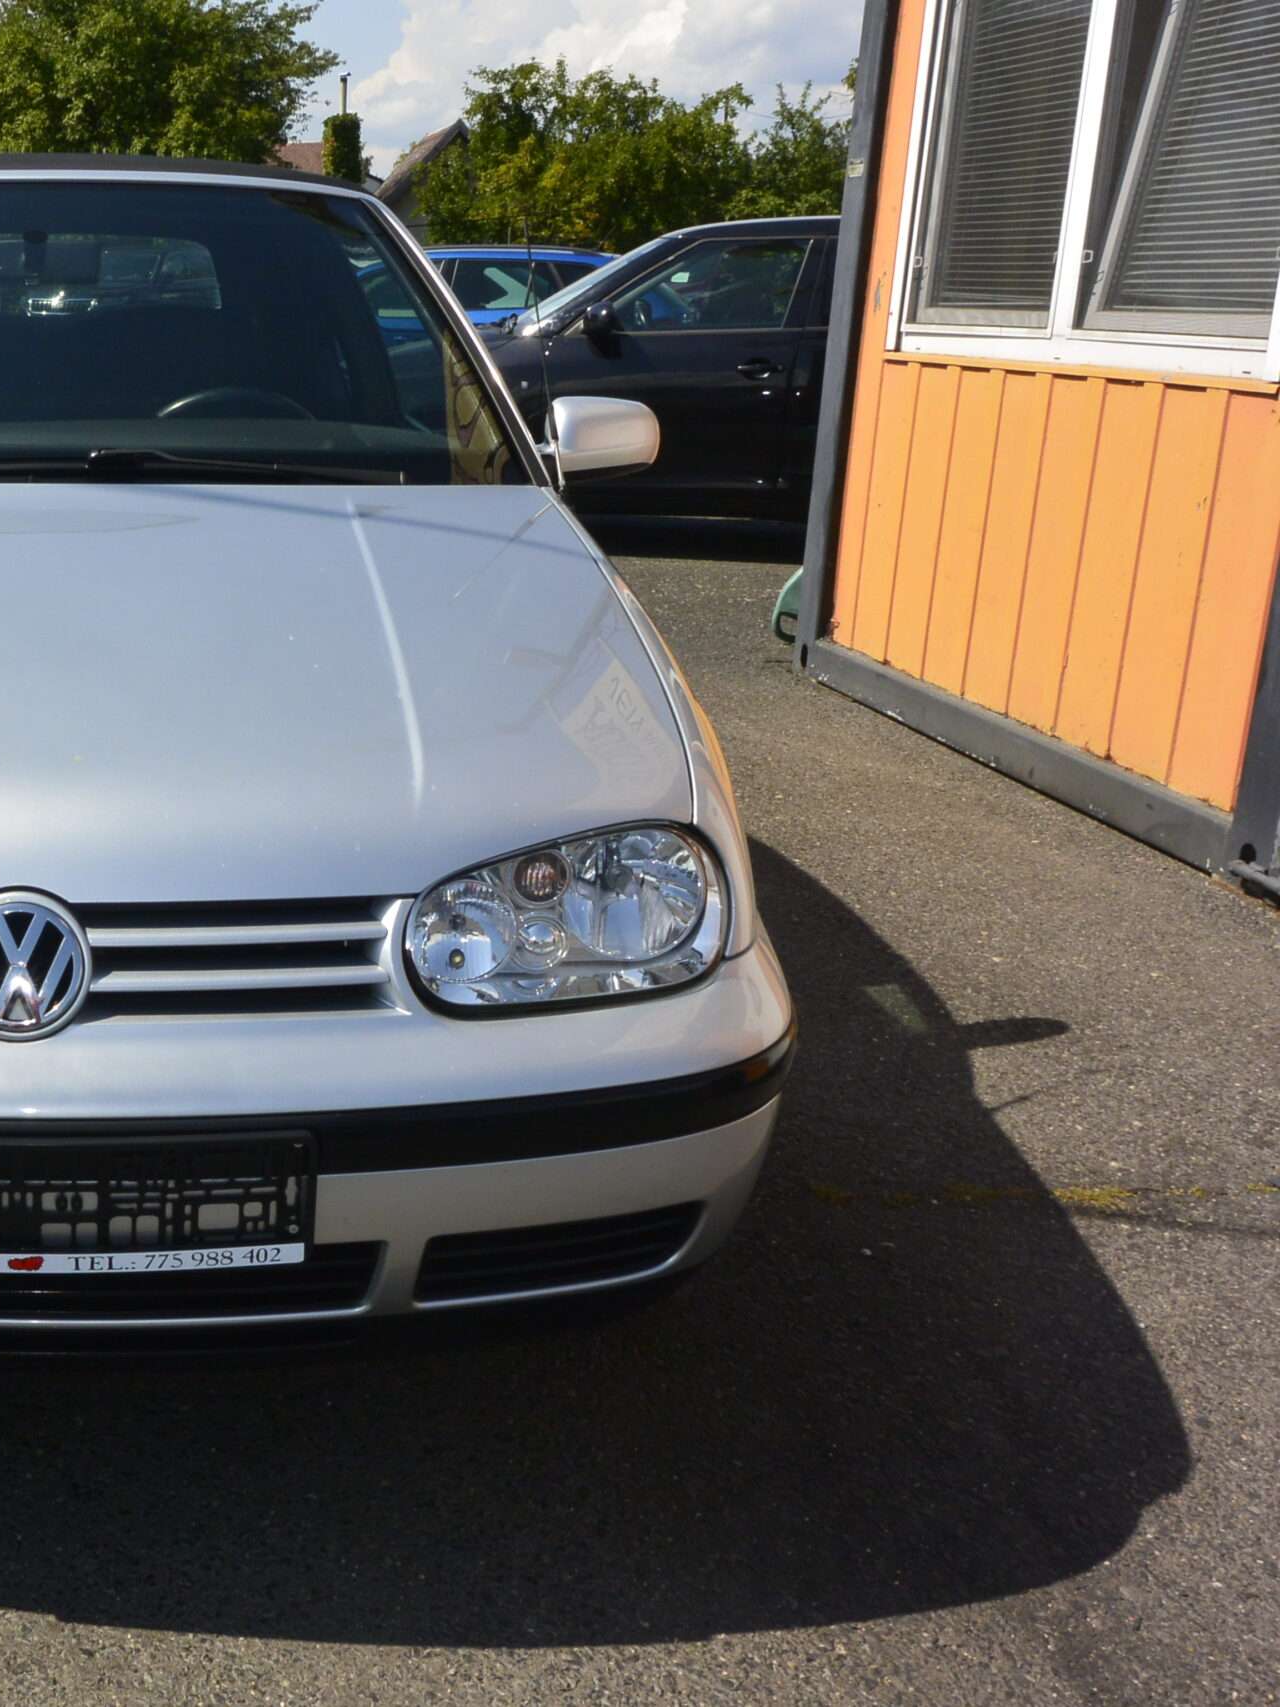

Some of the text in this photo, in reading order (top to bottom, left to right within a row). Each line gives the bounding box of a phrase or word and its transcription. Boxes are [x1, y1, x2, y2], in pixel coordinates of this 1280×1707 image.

[67, 1255, 137, 1271] TEL.:
[144, 1253, 184, 1269] 775
[191, 1250, 234, 1267] 988
[241, 1247, 282, 1264] 402
